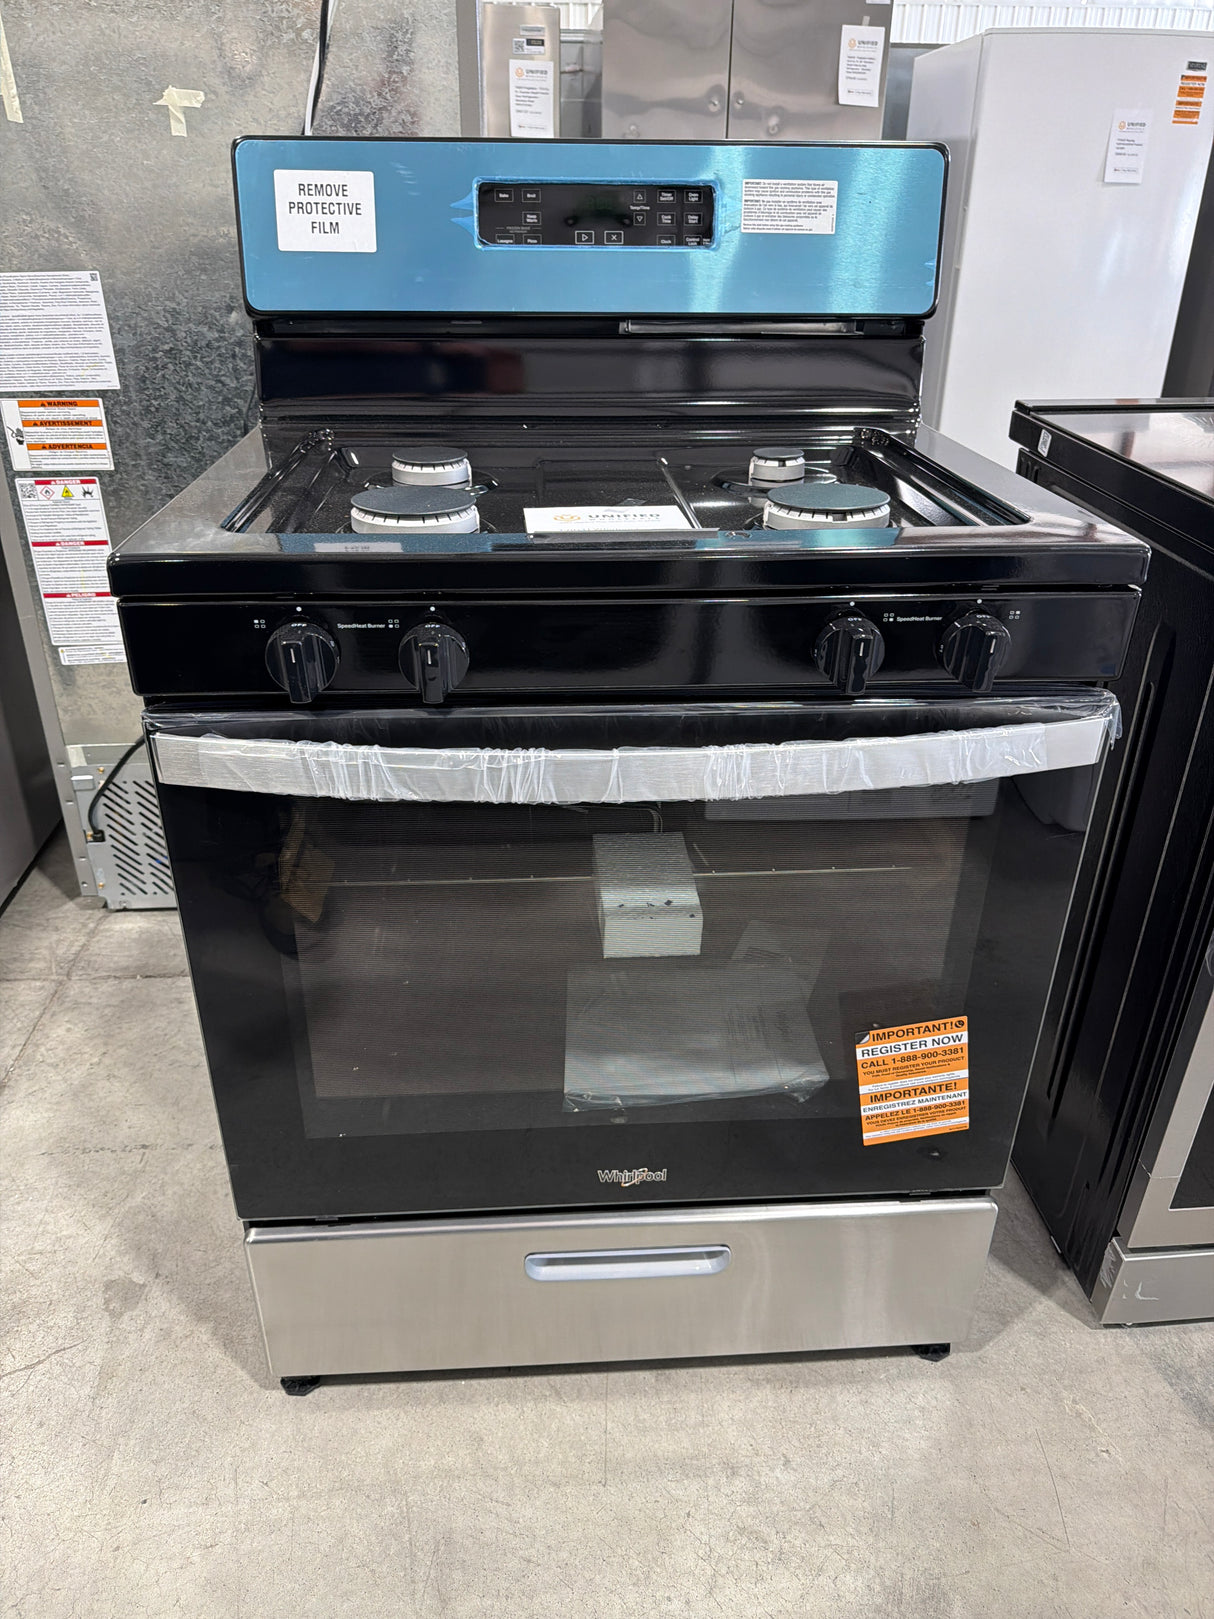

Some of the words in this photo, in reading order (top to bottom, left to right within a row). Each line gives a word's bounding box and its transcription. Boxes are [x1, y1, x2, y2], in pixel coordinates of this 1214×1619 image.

[298, 184, 349, 197] REMOVE
[288, 201, 362, 216] PROTECTIVE
[311, 221, 340, 235] FILM
[872, 1021, 954, 1042] IMPORTANT!
[861, 1039, 928, 1058] REGISTER
[931, 1033, 964, 1049] NOW
[861, 1059, 889, 1069] CALL
[891, 1046, 964, 1064] 1-888-900-3381
[892, 1064, 921, 1072] REGISTER
[937, 1056, 965, 1065] PRODUCT
[863, 1100, 916, 1113] ENREGISTREZ
[918, 1091, 968, 1105] MAINTENANT
[870, 1082, 957, 1103] IMPORTANTE!
[865, 1111, 900, 1122] APPELEZ
[913, 1100, 965, 1114] 1-888-900-3381
[945, 1106, 966, 1114] PRODUIT
[597, 1168, 667, 1186] Whirlpool
